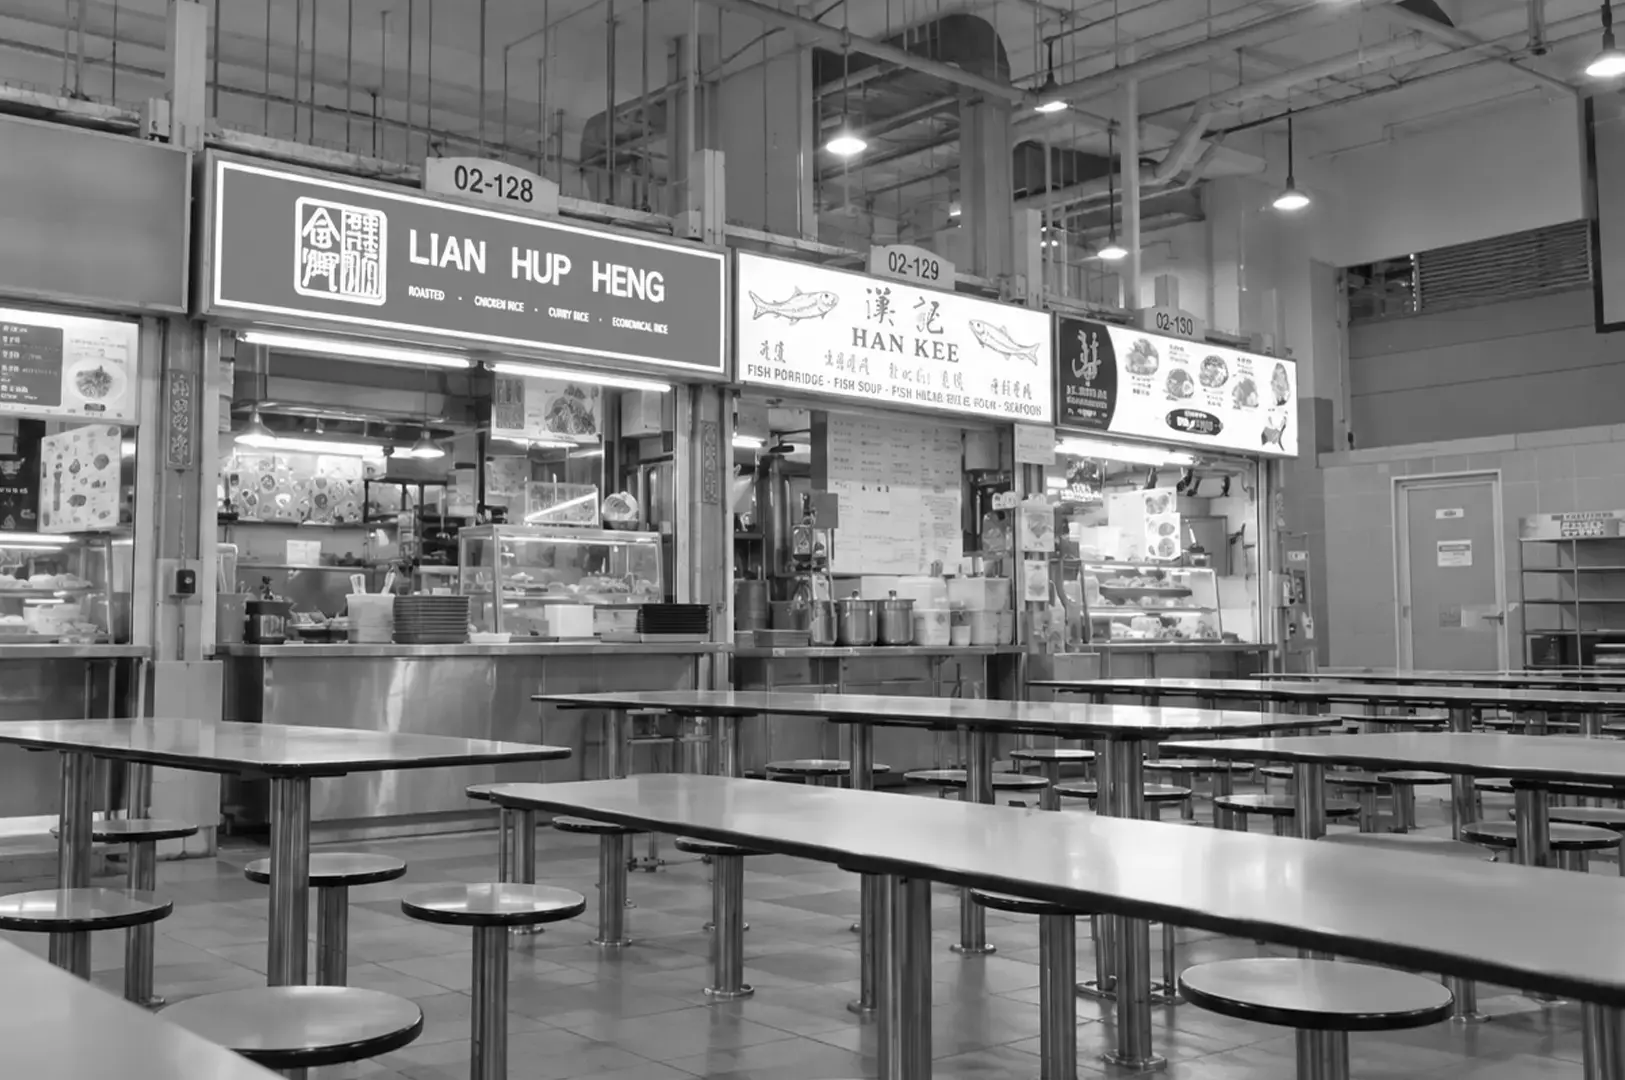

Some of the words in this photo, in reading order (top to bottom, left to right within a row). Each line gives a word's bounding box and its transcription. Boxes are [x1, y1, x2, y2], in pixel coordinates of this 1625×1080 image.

[454, 165, 534, 203] 02-128
[409, 229, 486, 273] LIAN
[511, 247, 572, 286] HUP
[592, 260, 665, 303] HENG
[888, 250, 939, 281] 02-129
[408, 285, 445, 301] ROASTED
[474, 295, 507, 310] CHICKEN
[507, 300, 525, 313] RICE
[573, 310, 589, 323] RICE
[1156, 312, 1193, 336] 02-130
[851, 326, 904, 354] HAN
[914, 338, 960, 363] KEE
[747, 363, 771, 379] FISH
[774, 367, 824, 386] PORRIDGE
[833, 377, 855, 391] FISH
[858, 380, 883, 394] SOUP
[891, 385, 912, 399] FISH
